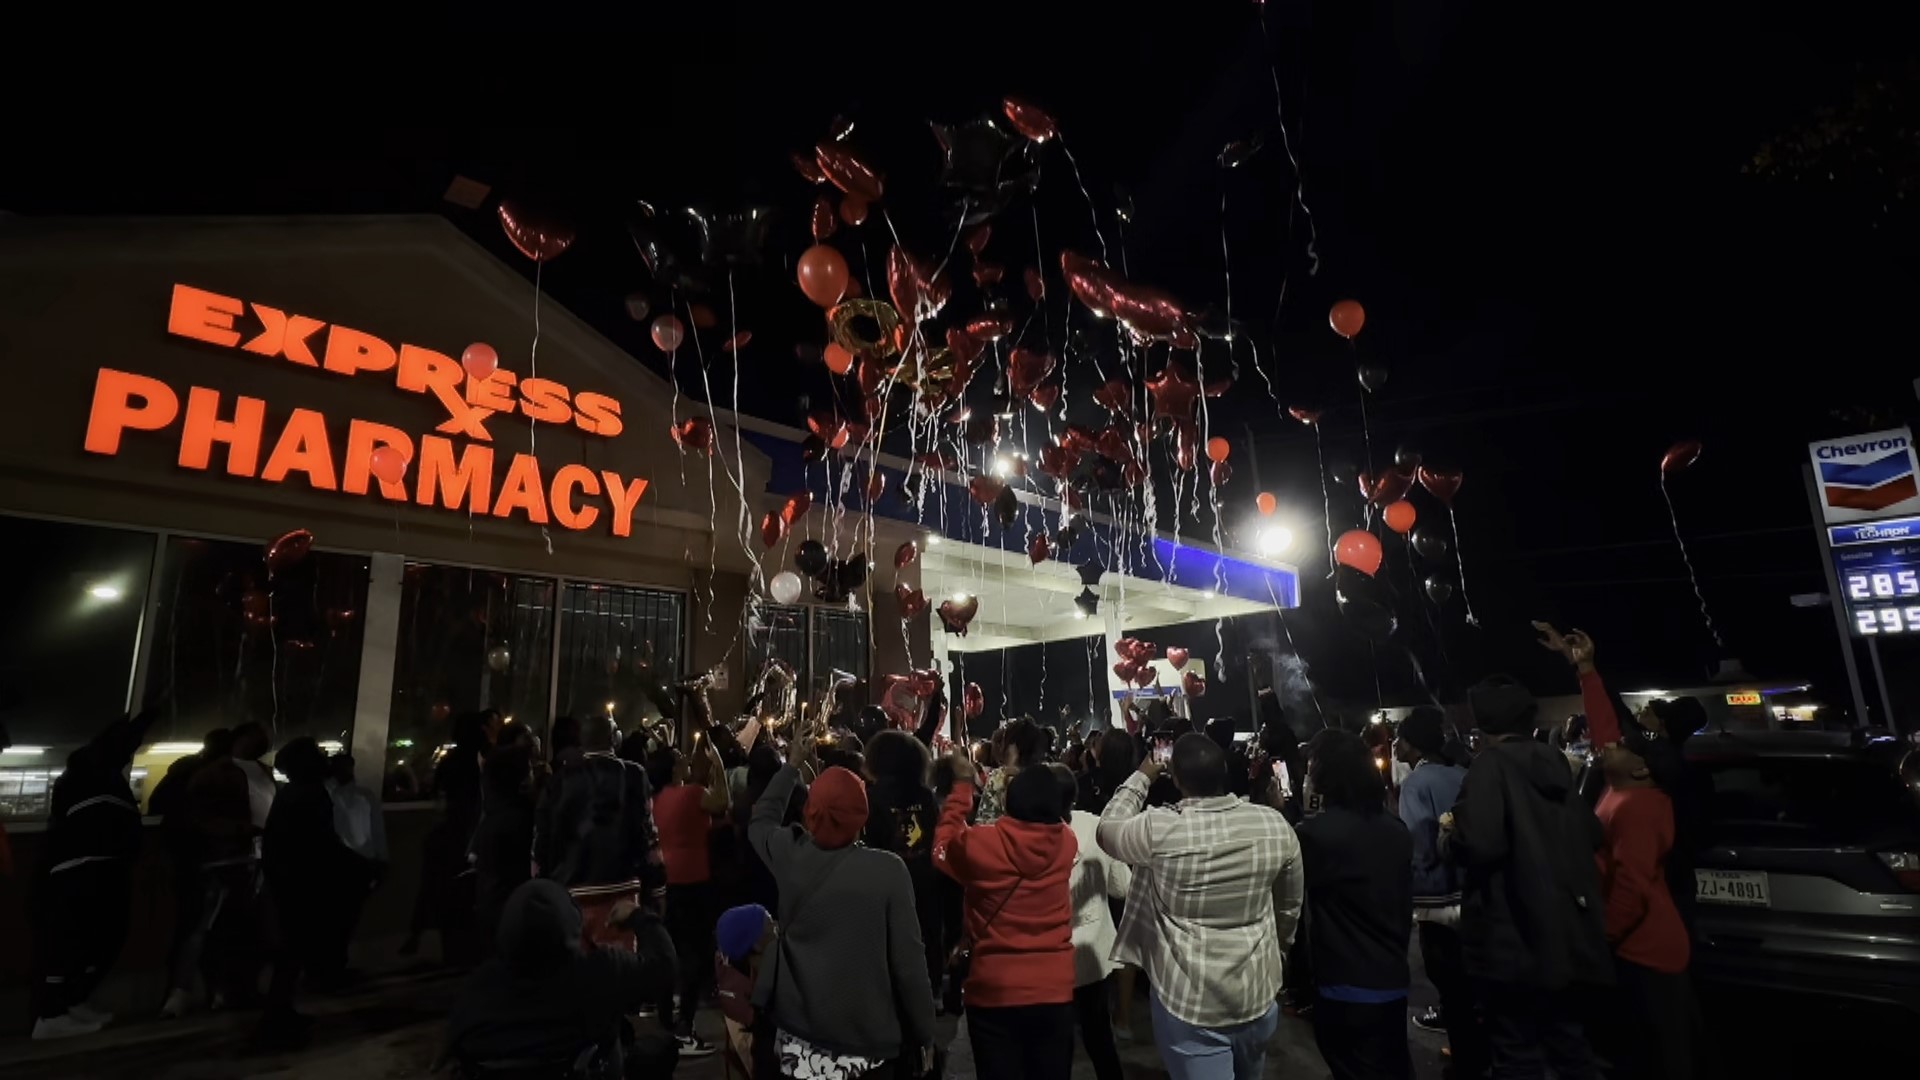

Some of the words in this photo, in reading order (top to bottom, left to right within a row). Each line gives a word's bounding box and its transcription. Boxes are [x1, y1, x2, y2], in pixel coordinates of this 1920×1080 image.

[166, 283, 624, 442] EXPRESS
[84, 367, 650, 538] PHARMACY
[1816, 436, 1907, 459] Chevron
[1848, 570, 1919, 599] 285
